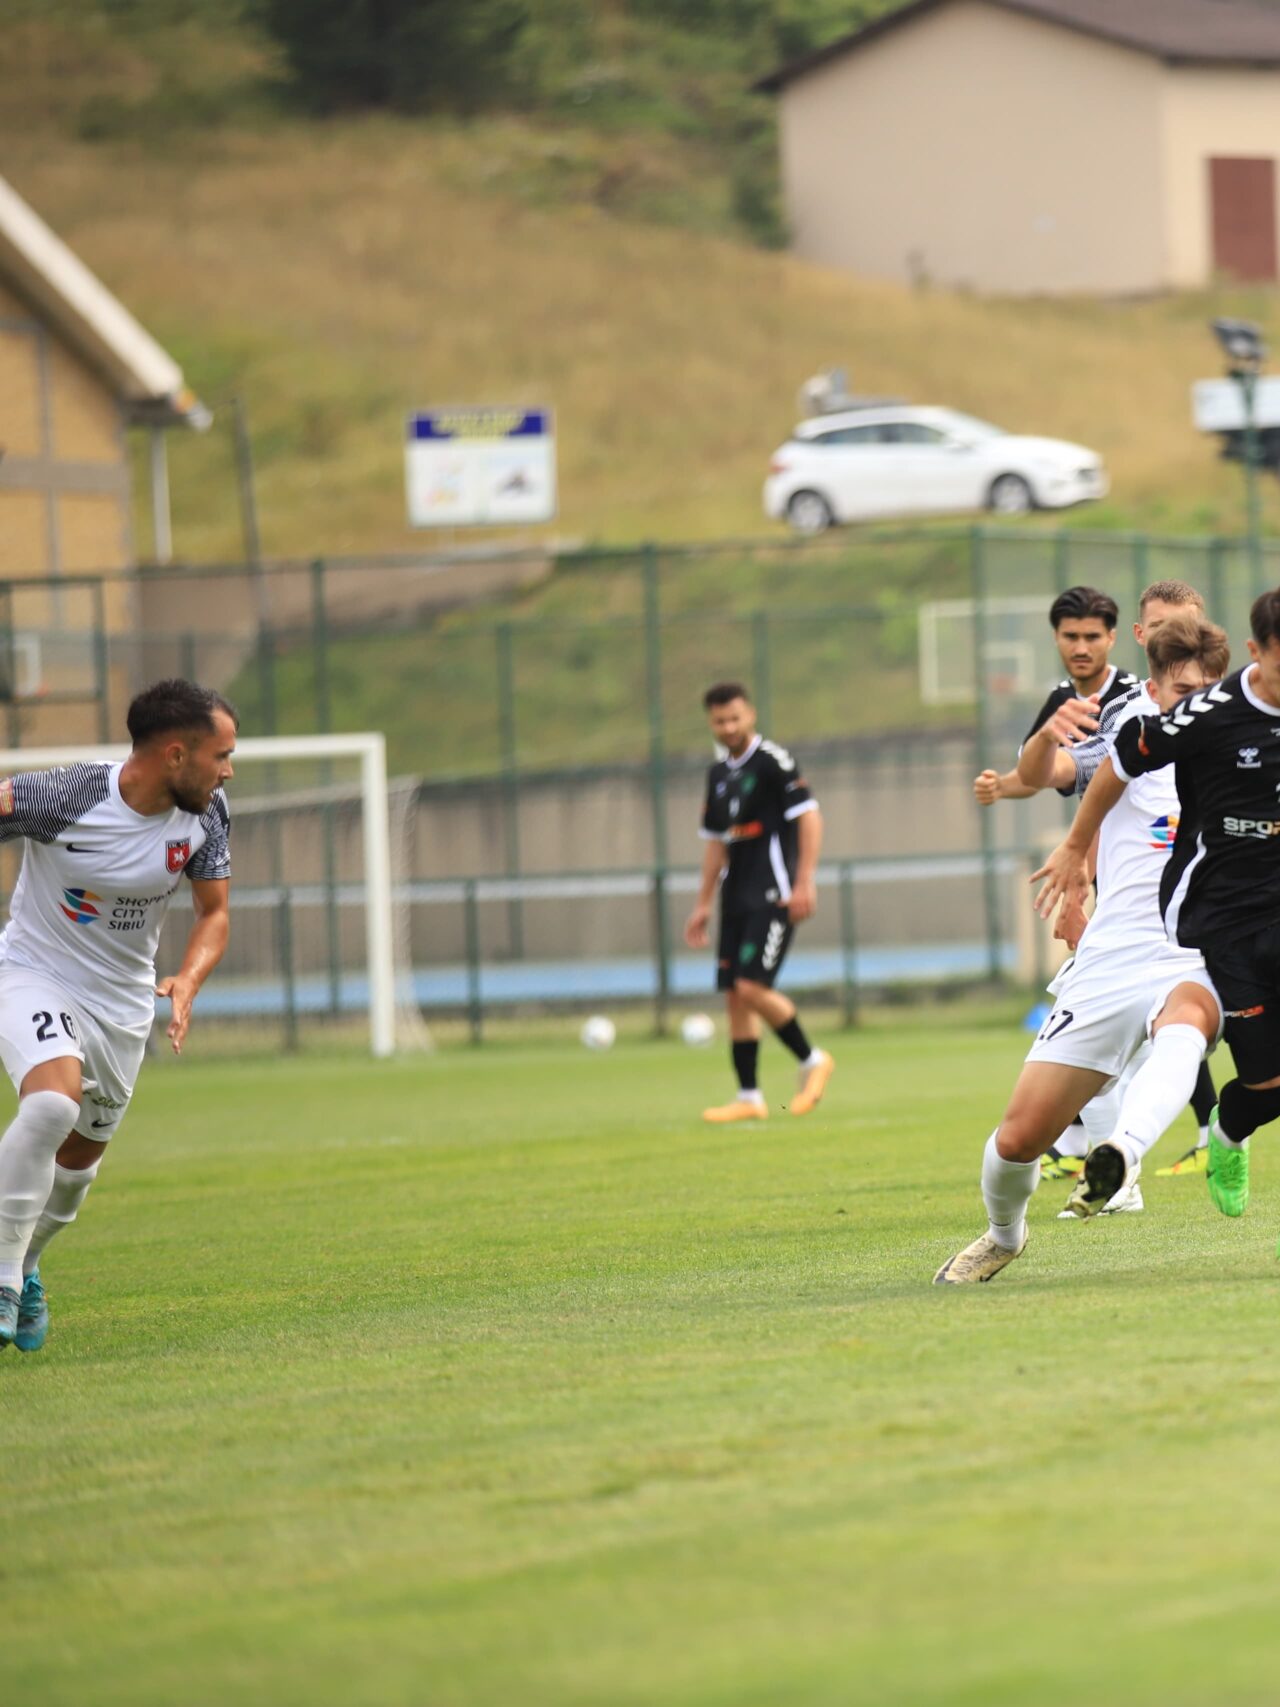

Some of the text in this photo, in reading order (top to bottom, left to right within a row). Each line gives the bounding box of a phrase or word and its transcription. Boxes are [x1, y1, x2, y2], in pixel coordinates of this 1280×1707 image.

[115, 886, 178, 906] SHOPP
[112, 908, 147, 918] CITY
[108, 920, 145, 930] SIBIU
